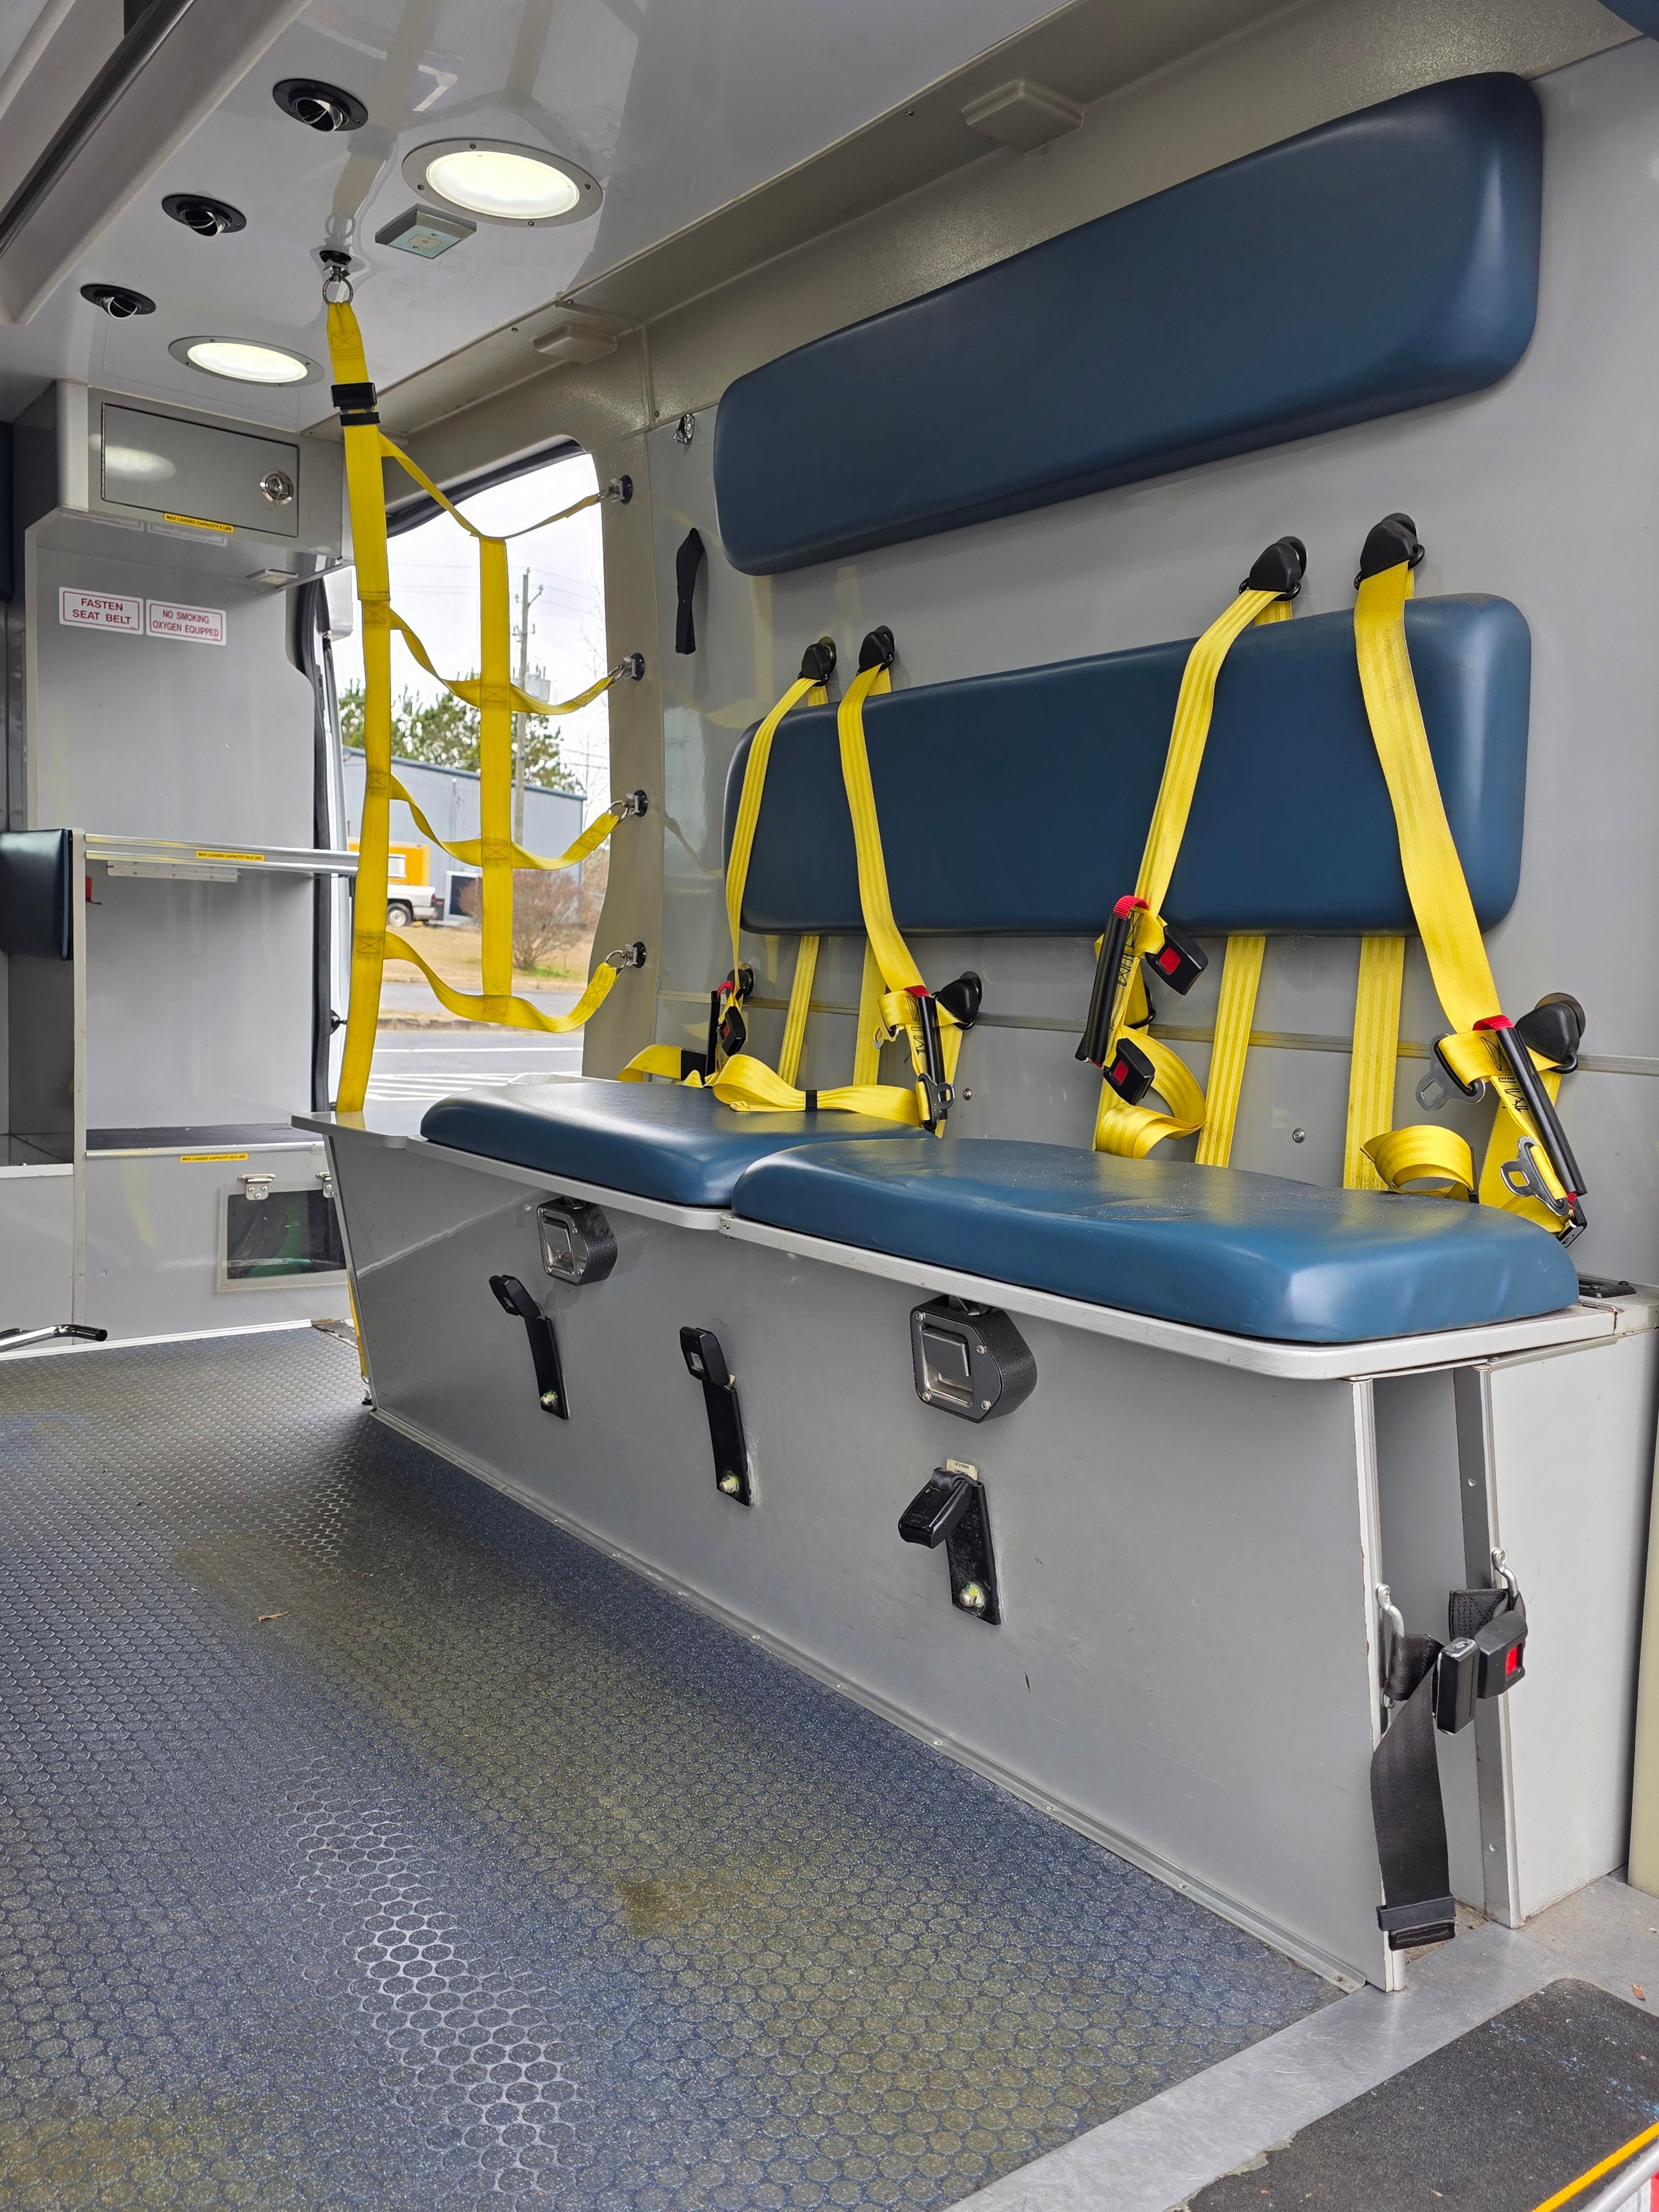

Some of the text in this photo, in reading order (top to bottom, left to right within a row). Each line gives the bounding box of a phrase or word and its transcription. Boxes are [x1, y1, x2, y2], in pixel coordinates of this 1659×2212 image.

[81, 598, 123, 611] FASTEN
[72, 609, 132, 624] SEAT BELT
[163, 610, 210, 624] NO SMOKING
[153, 620, 218, 637] OXYGEN EQUIPPED
